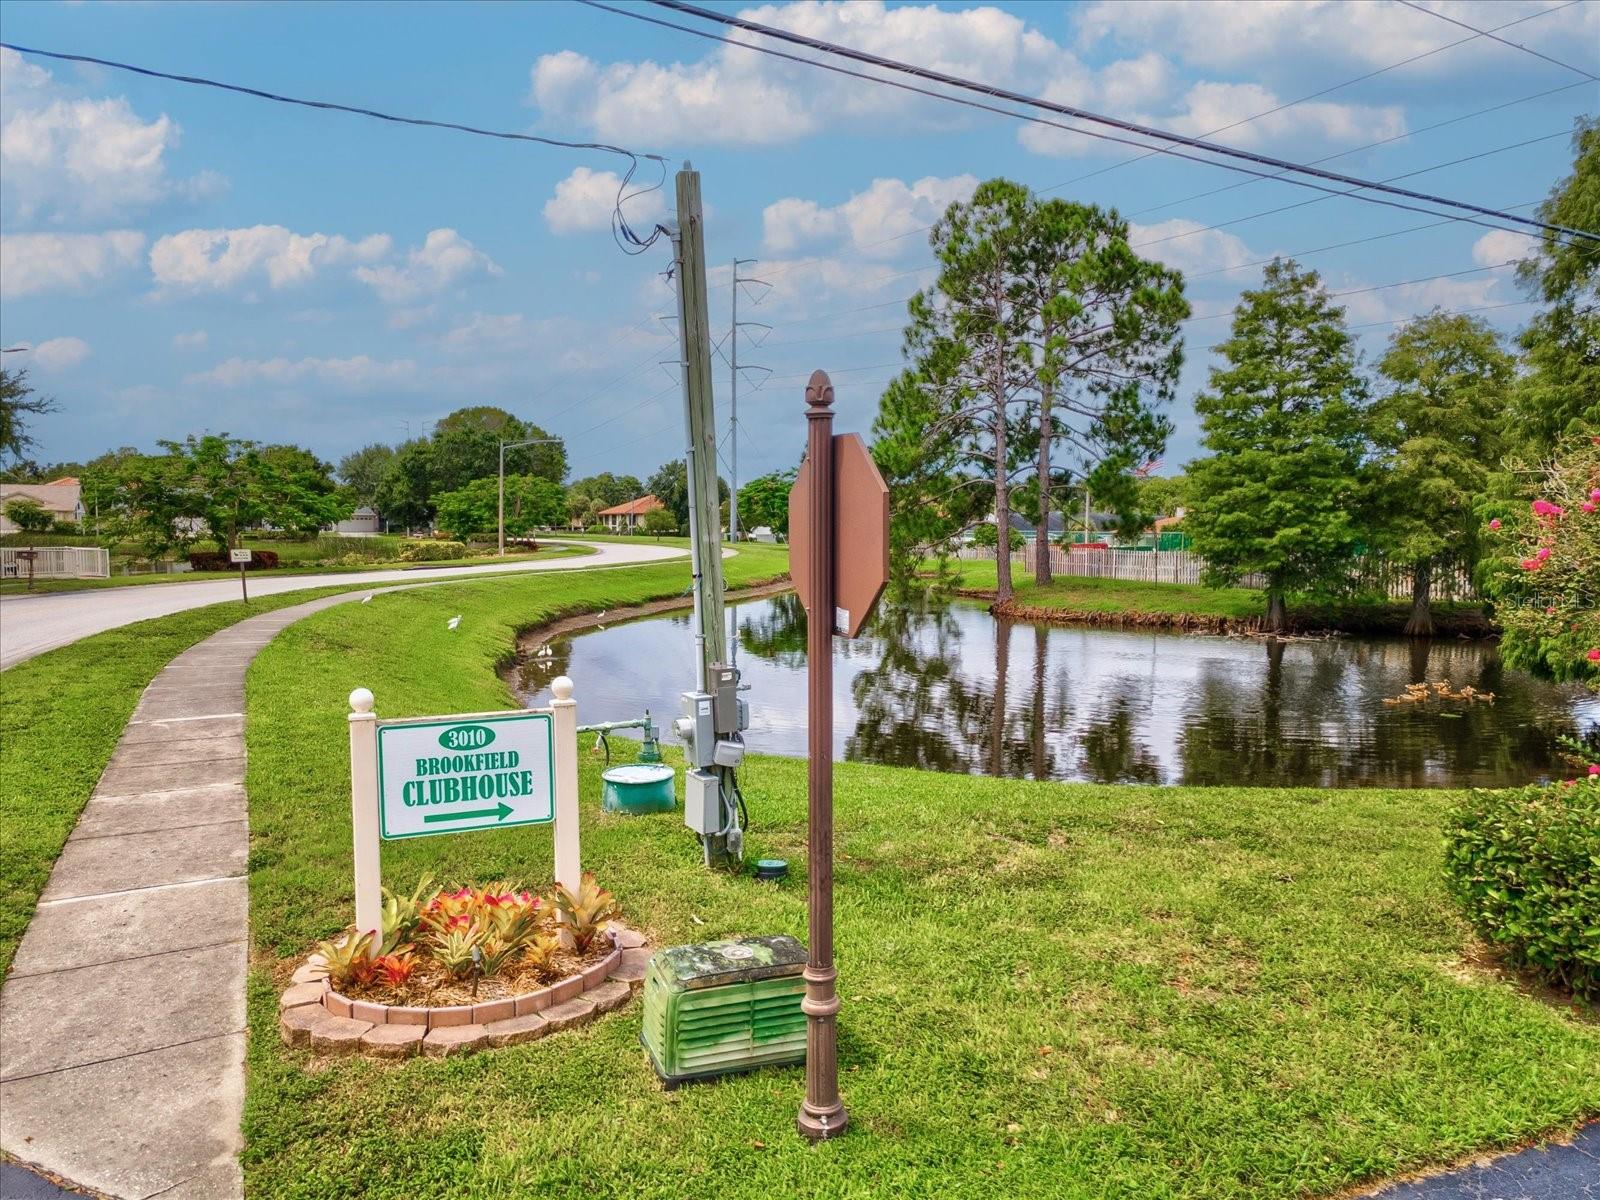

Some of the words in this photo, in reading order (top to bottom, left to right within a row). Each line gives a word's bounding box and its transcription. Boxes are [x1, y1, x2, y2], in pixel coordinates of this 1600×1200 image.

[448, 729, 486, 748] 3010
[416, 751, 519, 776] BROOKFIELD
[403, 771, 533, 807] CLUBHOUSE
